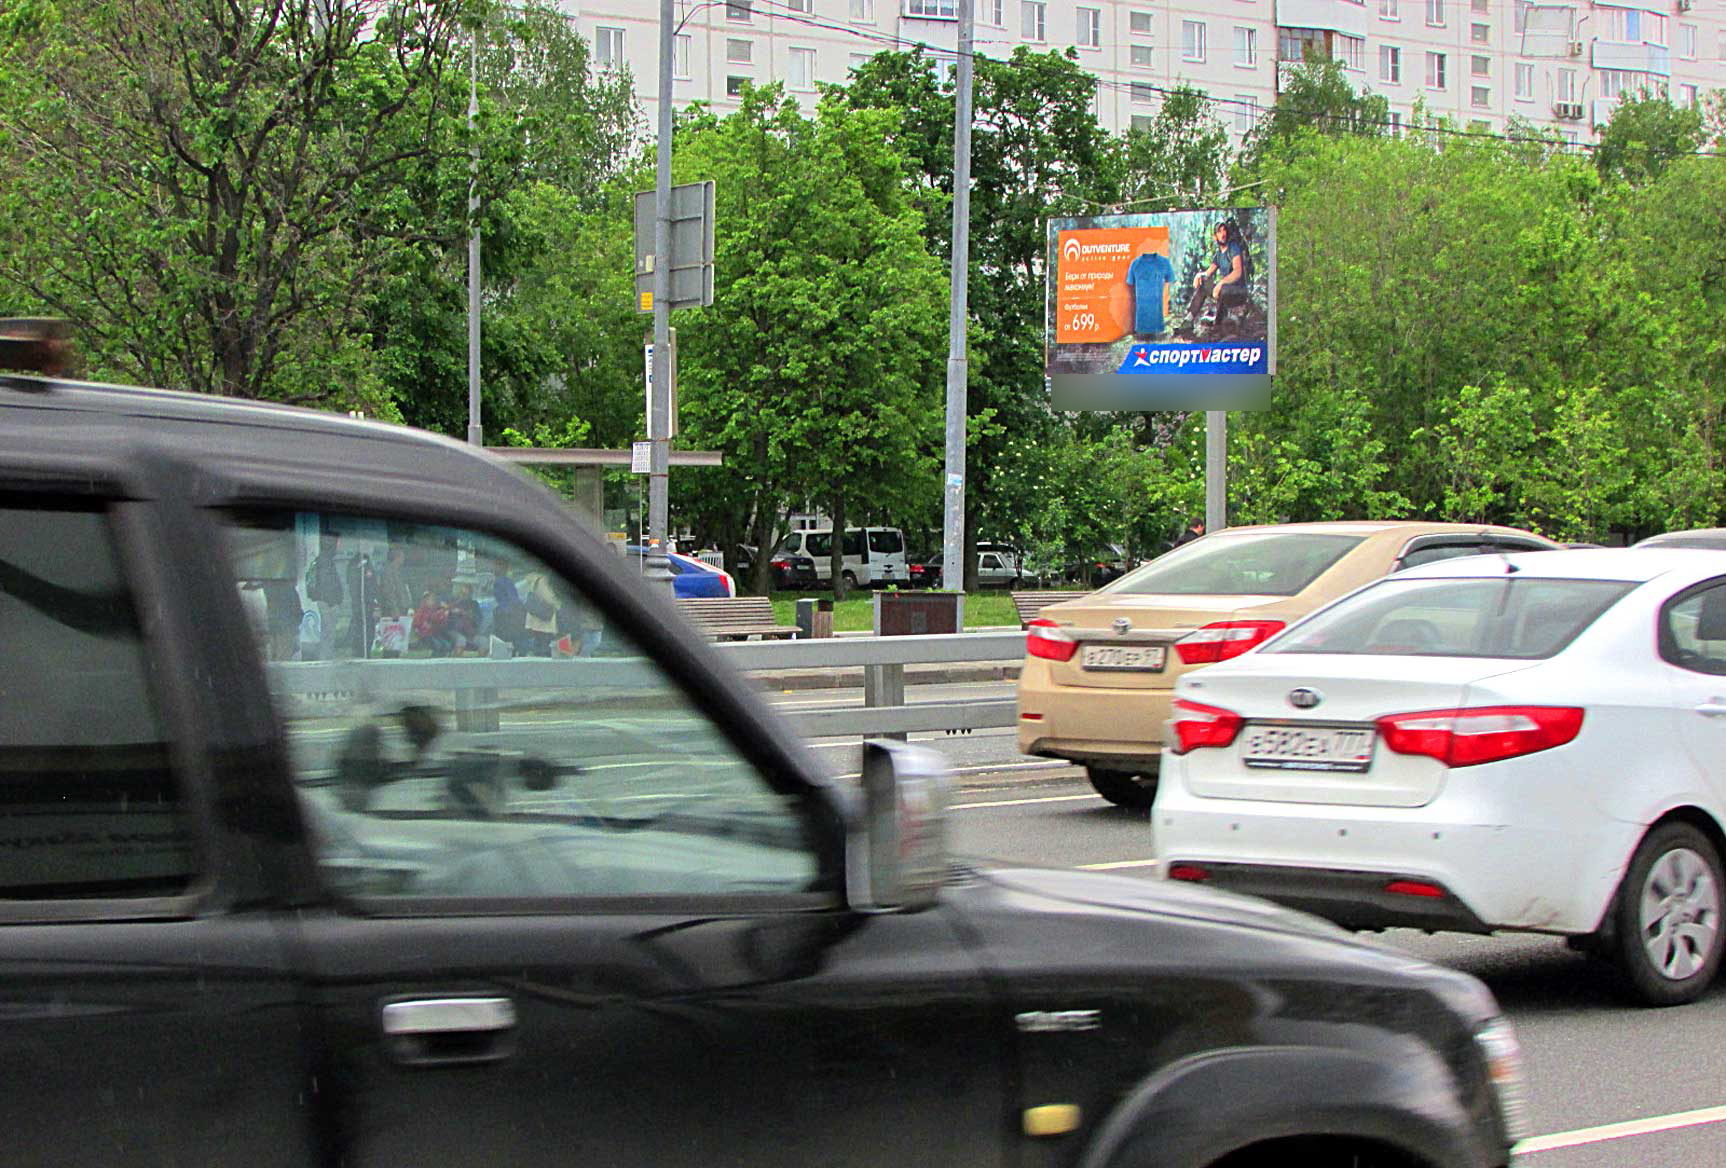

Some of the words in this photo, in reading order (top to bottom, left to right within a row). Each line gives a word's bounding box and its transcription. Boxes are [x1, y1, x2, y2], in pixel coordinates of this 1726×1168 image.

[1081, 243, 1130, 253] OUTVENTURE
[1065, 271, 1079, 282] Бери
[1087, 271, 1114, 281] природы
[1064, 323, 1070, 331] от
[1072, 313, 1095, 331] 699
